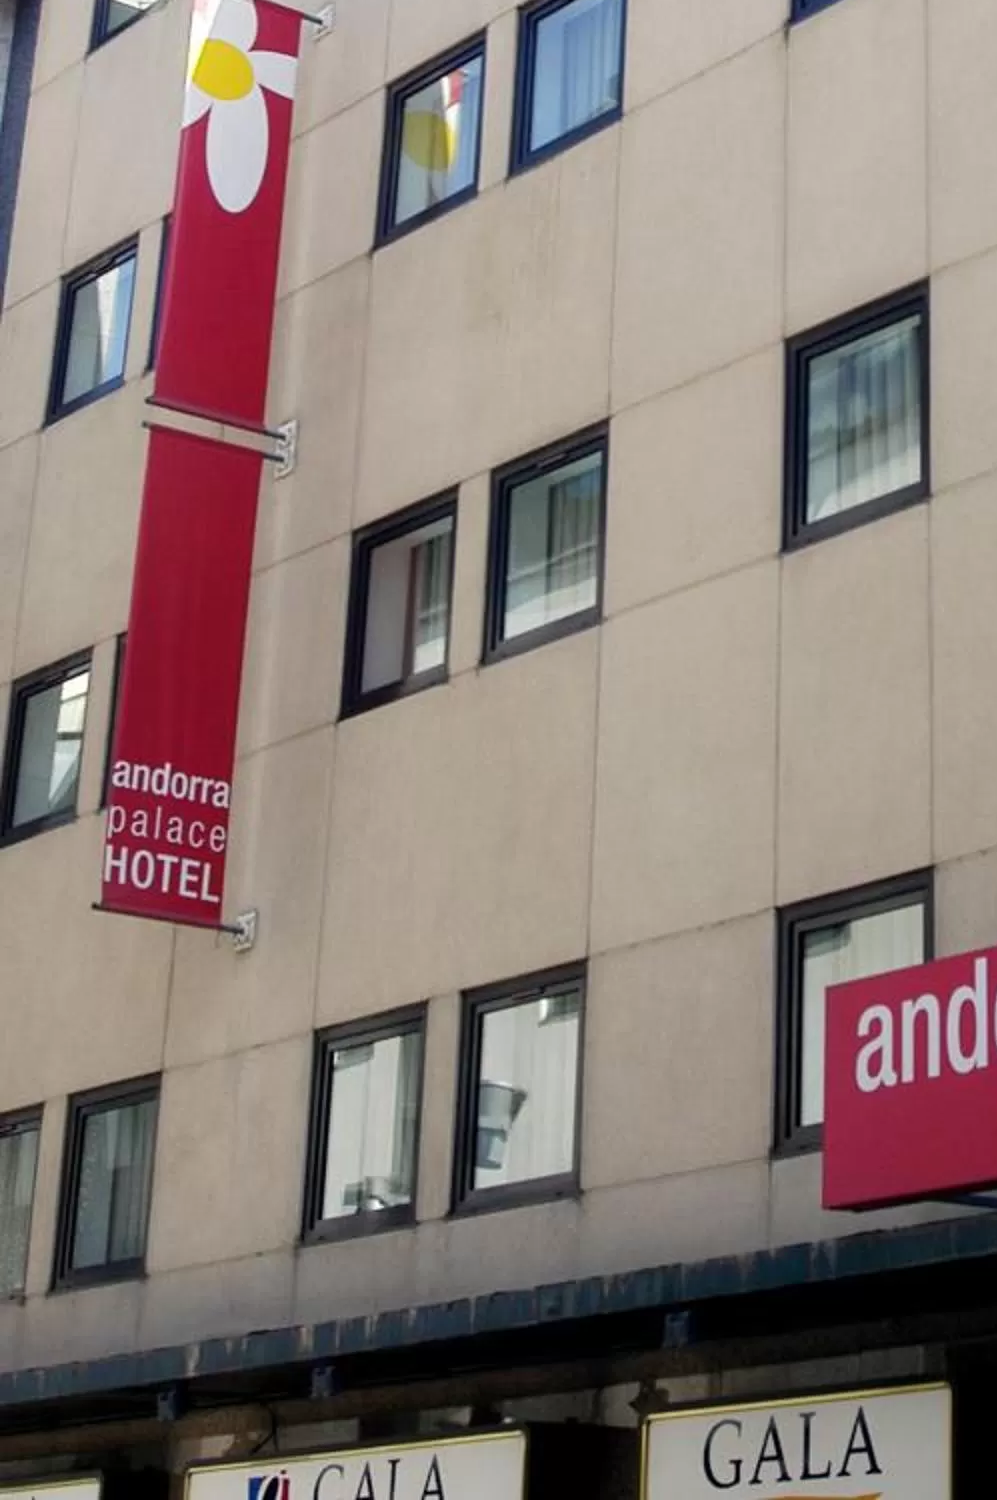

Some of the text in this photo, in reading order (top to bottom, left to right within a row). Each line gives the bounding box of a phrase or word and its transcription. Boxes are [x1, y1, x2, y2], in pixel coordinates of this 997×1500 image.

[111, 760, 230, 809] andorra
[107, 805, 226, 852] palace
[104, 845, 219, 903] HOTEL
[703, 1405, 883, 1489] GALA
